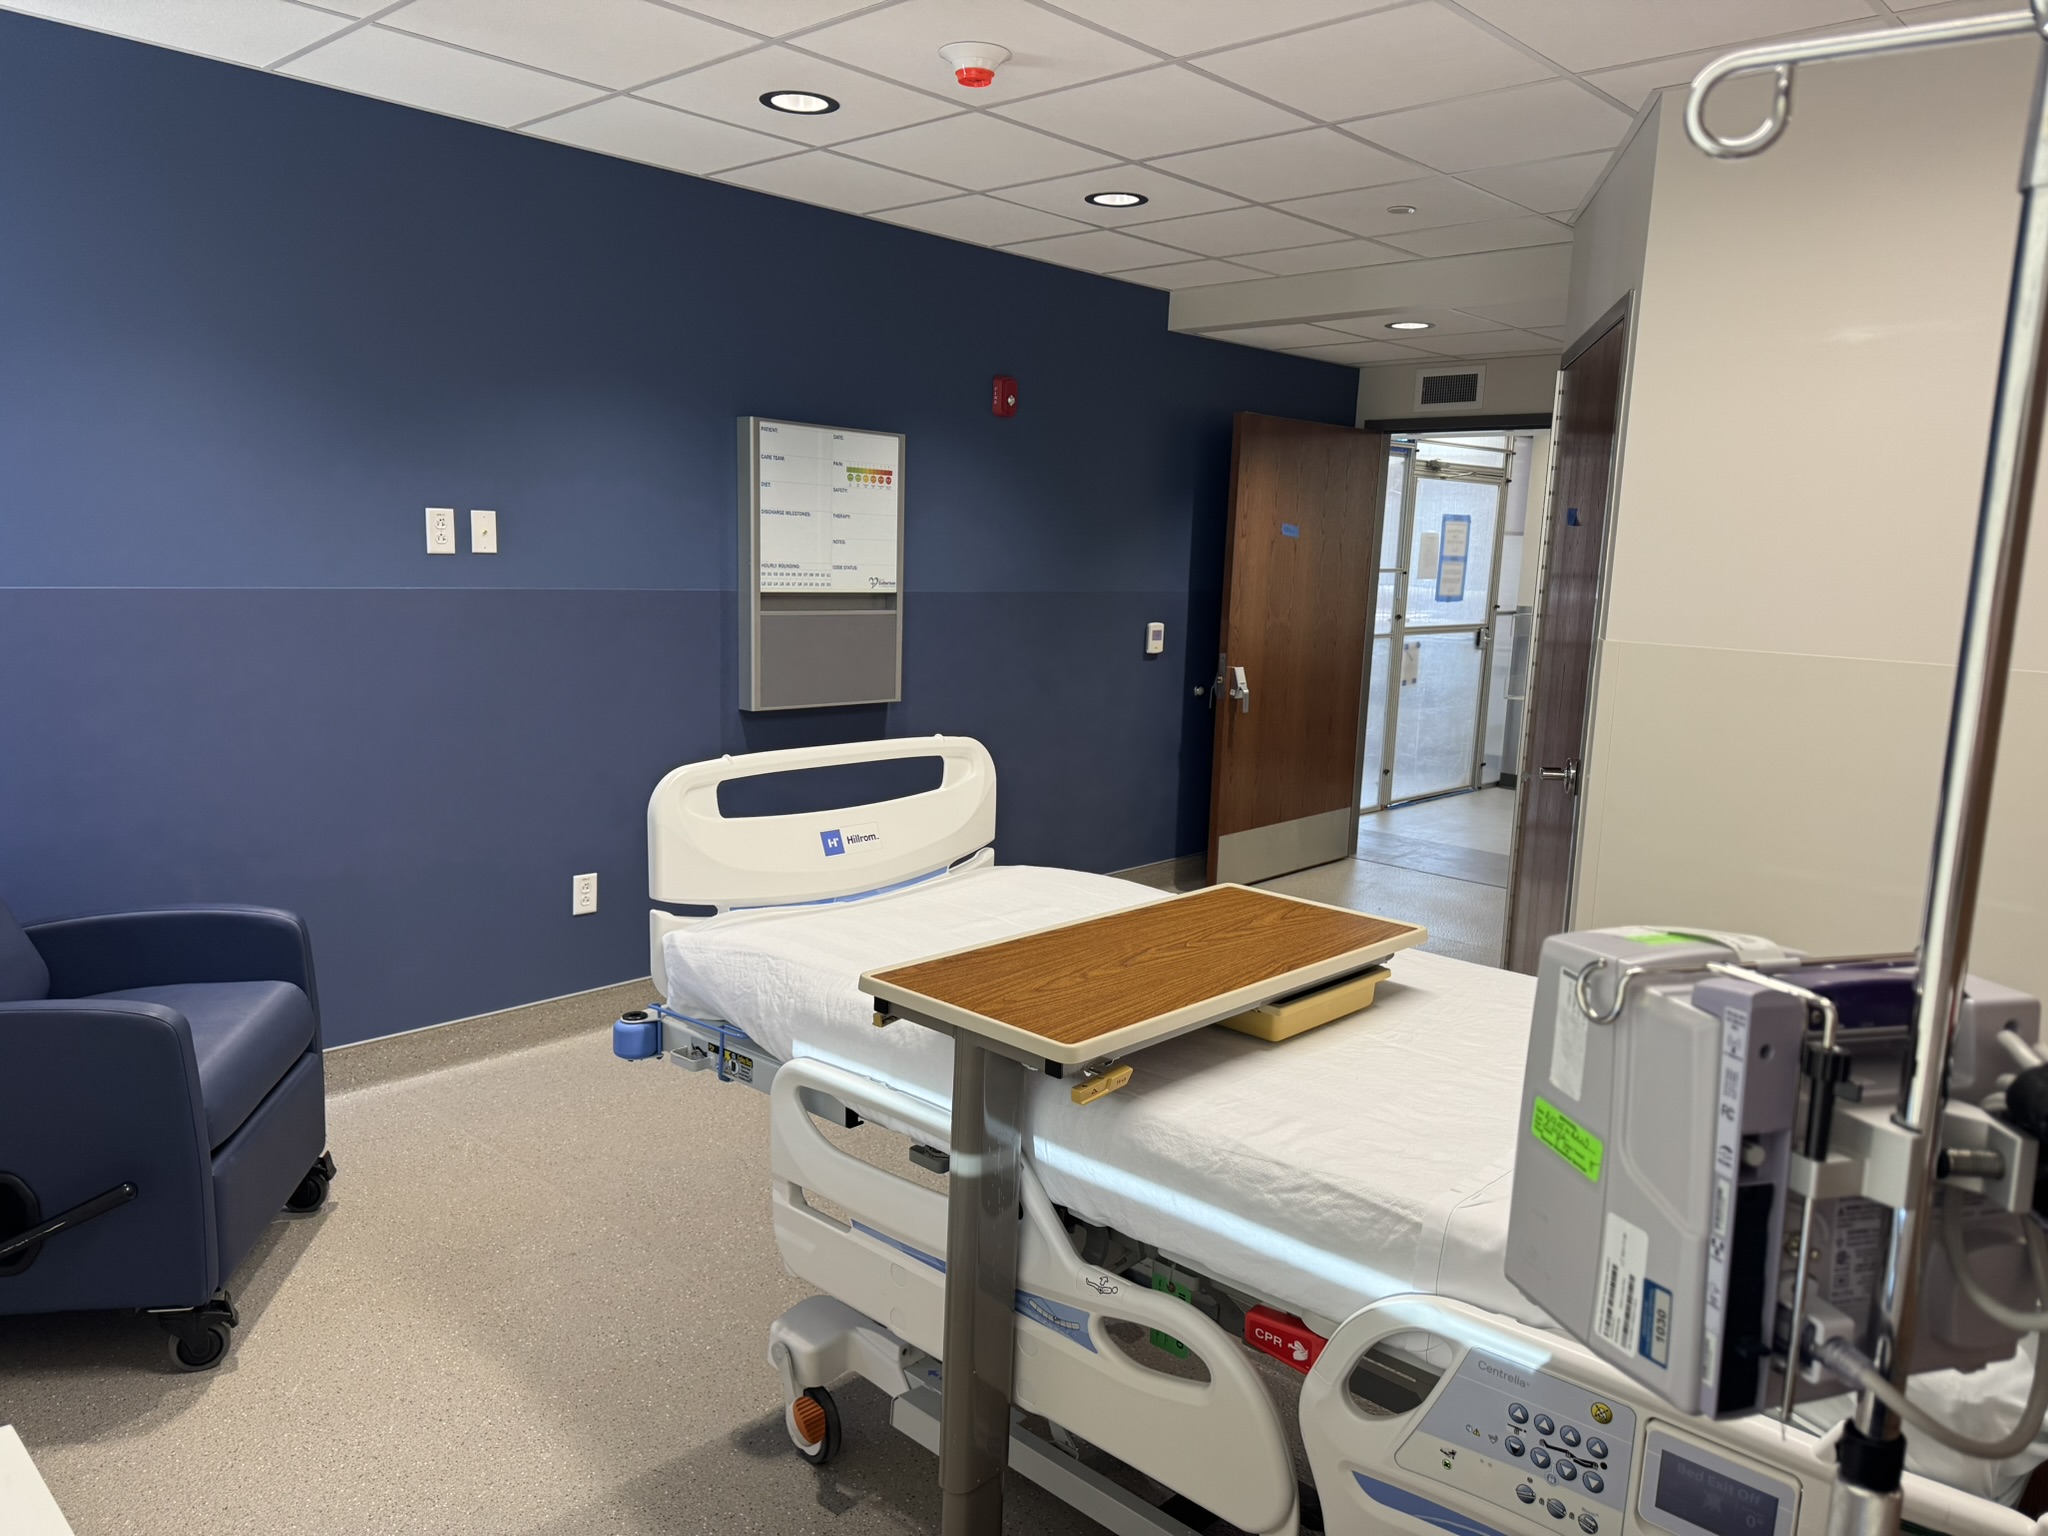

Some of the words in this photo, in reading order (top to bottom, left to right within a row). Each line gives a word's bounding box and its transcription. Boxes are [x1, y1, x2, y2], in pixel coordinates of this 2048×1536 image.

[1255, 1328, 1282, 1348] CPR
[1676, 1462, 1704, 1482] Bed
[1708, 1476, 1736, 1496] Exit
[1738, 1488, 1760, 1505] Off
